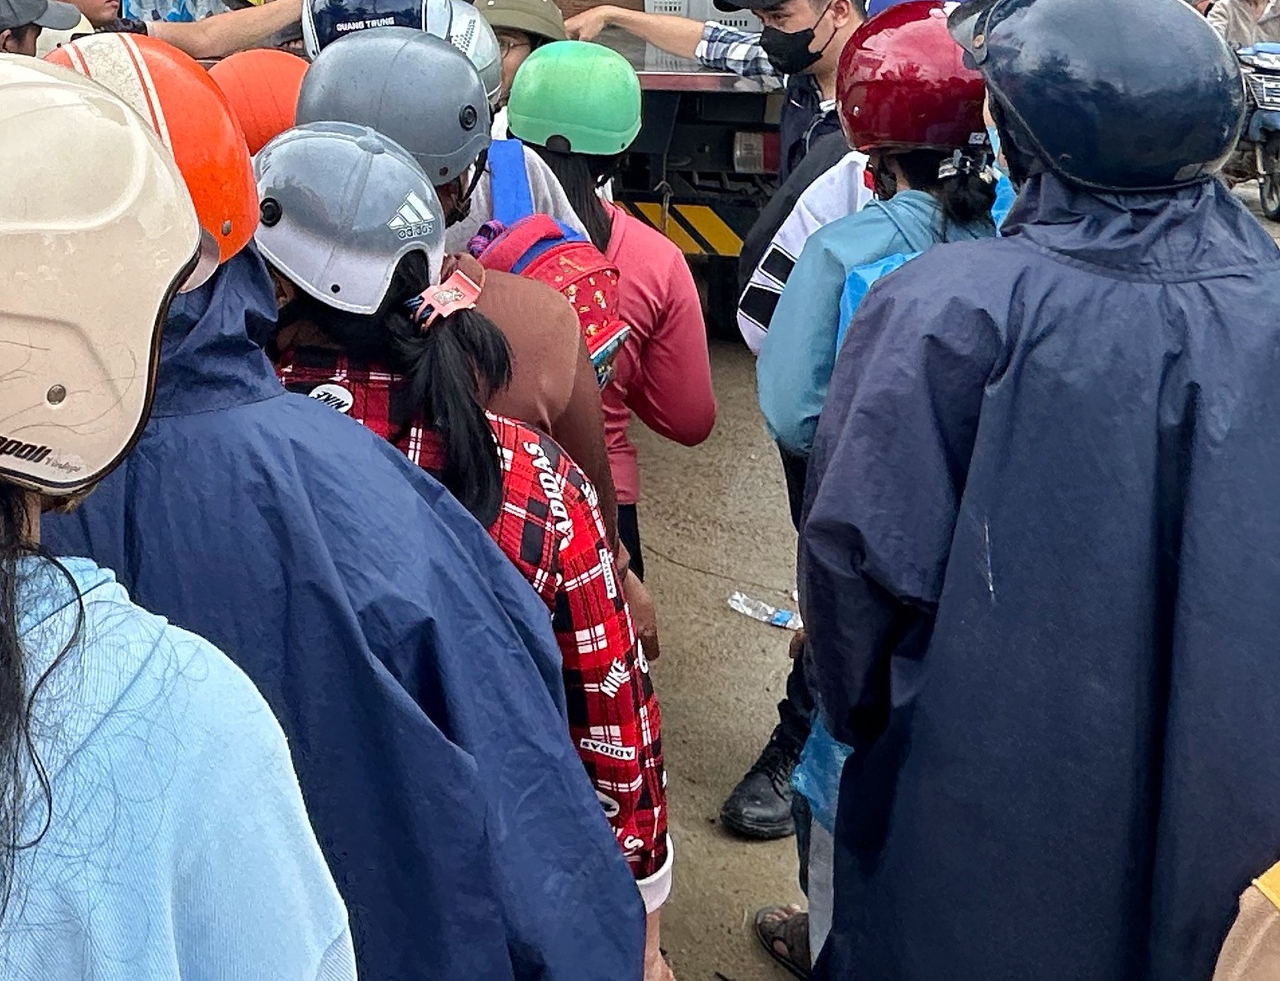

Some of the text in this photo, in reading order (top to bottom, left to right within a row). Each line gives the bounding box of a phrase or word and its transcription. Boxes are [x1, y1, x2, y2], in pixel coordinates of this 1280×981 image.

[336, 16, 395, 33] QUANG TRUNG
[397, 222, 434, 240] adidas
[523, 441, 574, 551] ADIDAS
[600, 657, 627, 698] NIKE
[582, 739, 634, 759] ADIDAS
